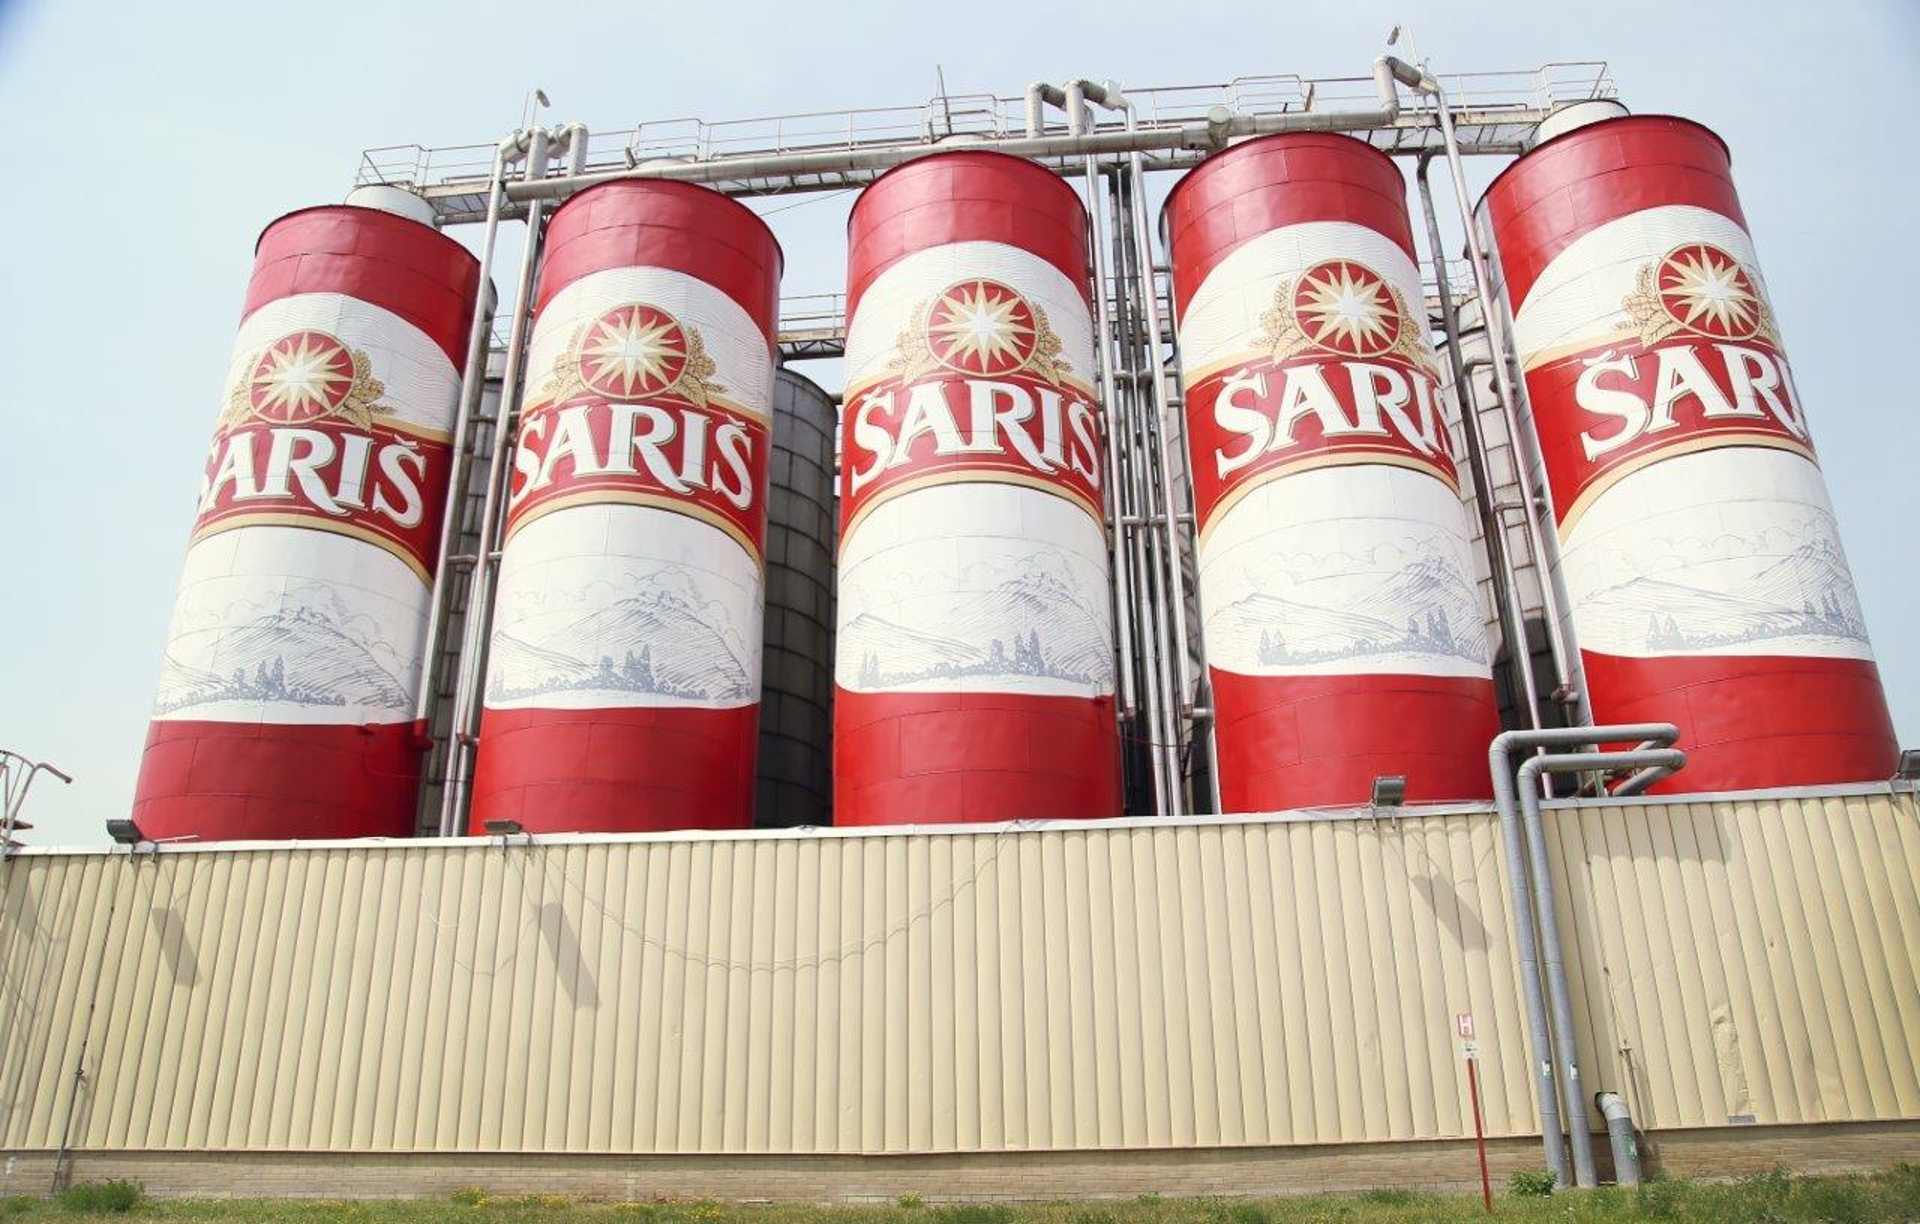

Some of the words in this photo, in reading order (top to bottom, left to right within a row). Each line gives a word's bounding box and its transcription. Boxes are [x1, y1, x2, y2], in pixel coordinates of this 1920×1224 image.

[196, 428, 426, 528] ARIŠ
[851, 379, 1100, 496] ŠARIŠ
[1213, 361, 1449, 480] ŠARI
